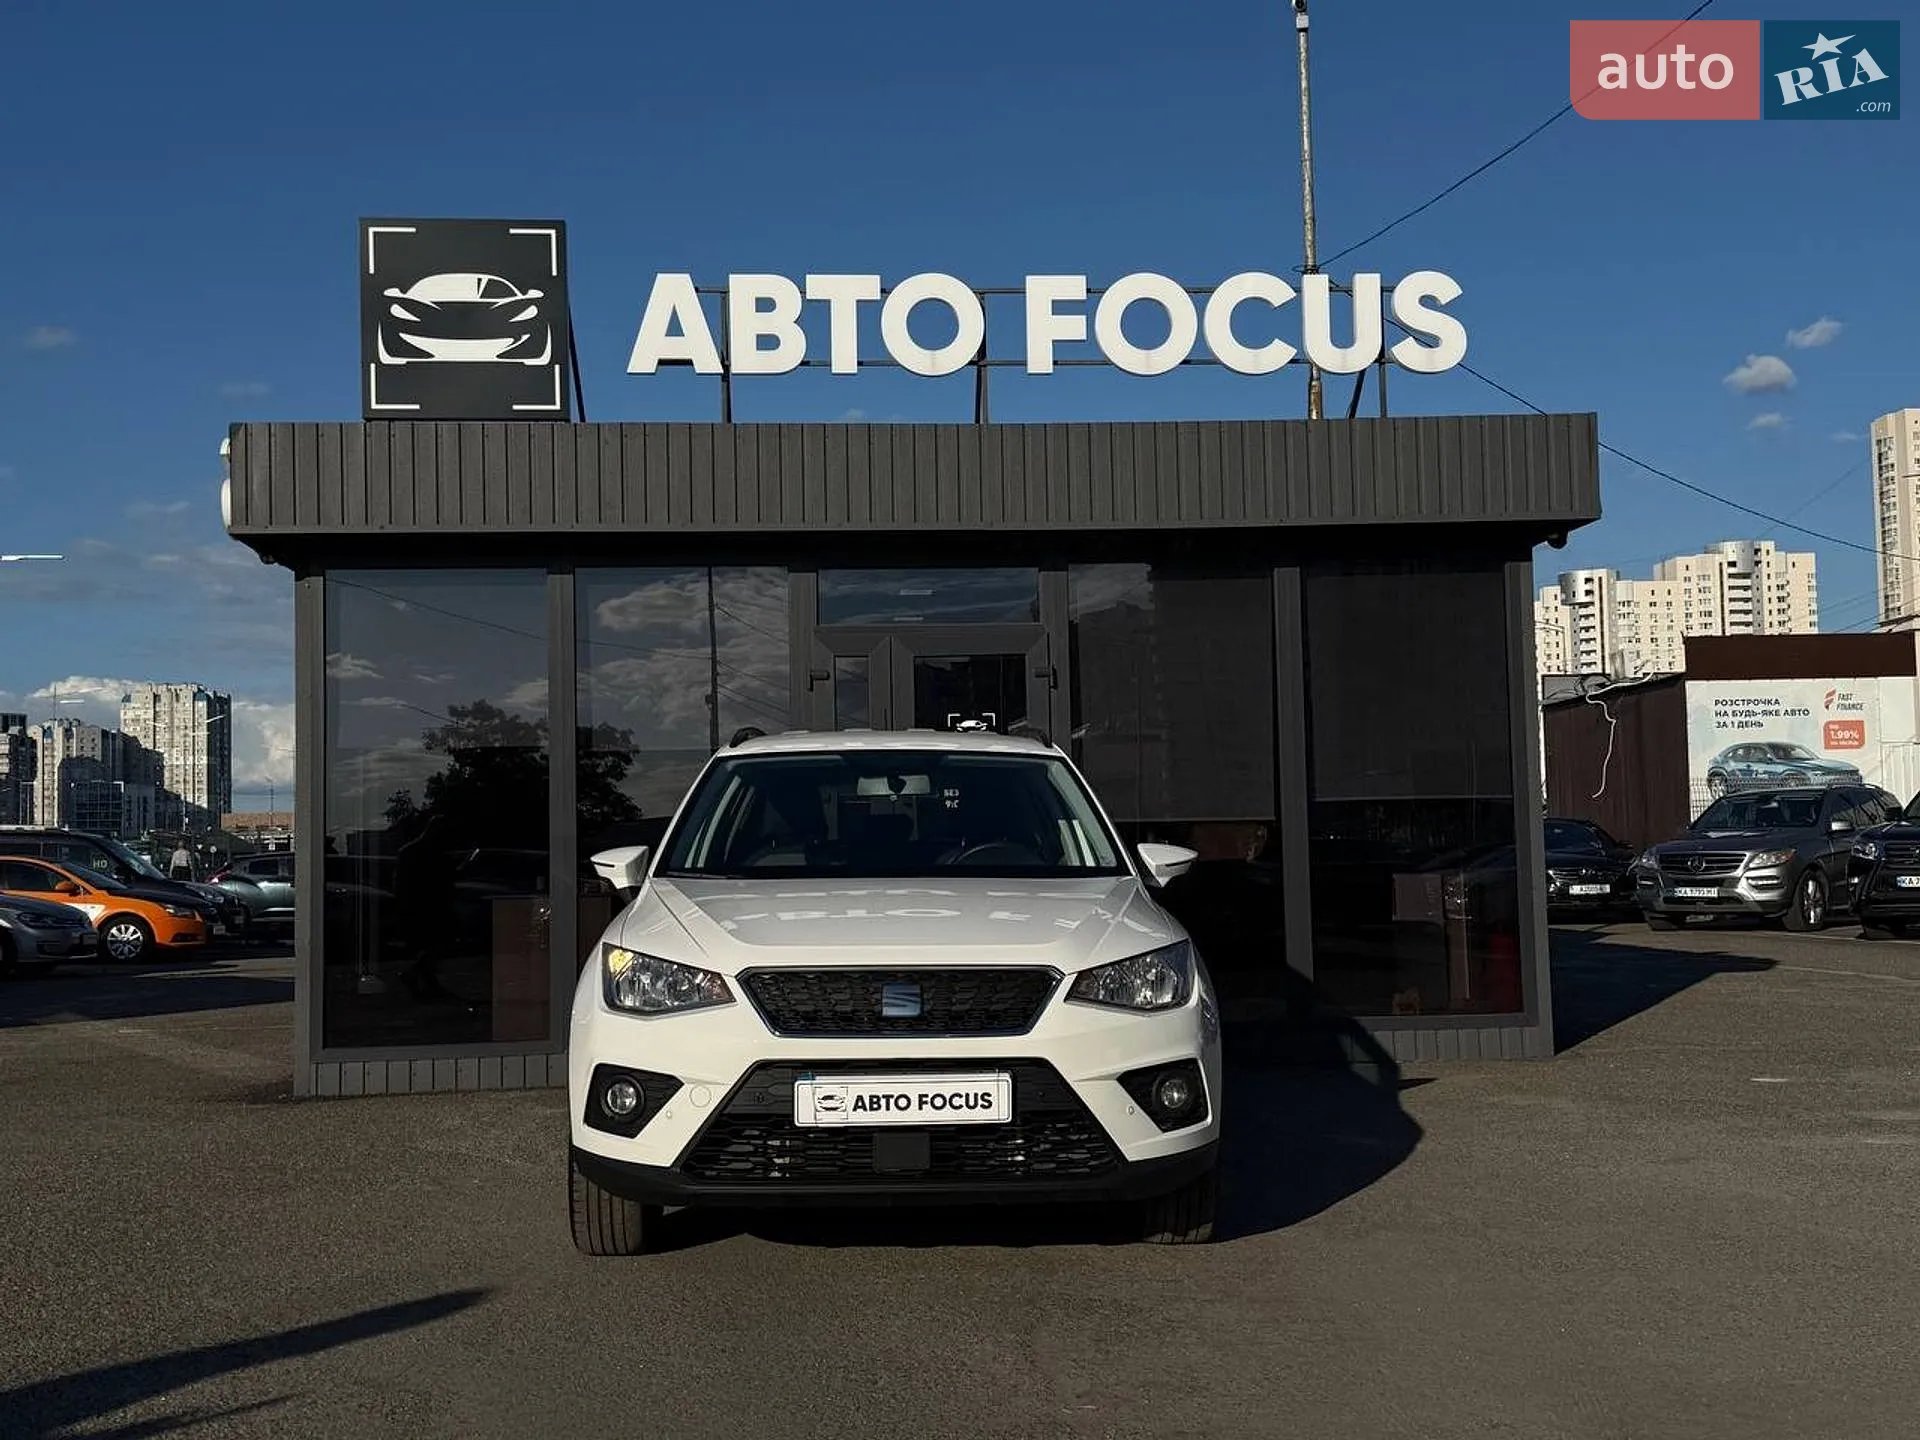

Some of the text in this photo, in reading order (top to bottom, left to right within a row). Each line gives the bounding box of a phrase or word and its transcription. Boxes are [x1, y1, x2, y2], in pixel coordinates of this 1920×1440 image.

[627, 271, 1468, 376] АВТО FOCUS
[1714, 698, 1781, 707] РОЗСТРОЧКА
[1714, 708, 1811, 719] НА БУДЬ-ЯКЕ АВТО
[1715, 721, 1728, 729] ЗА
[1736, 720, 1764, 729] ДЕНЬ
[852, 1092, 993, 1112] АВТО FOCUS
